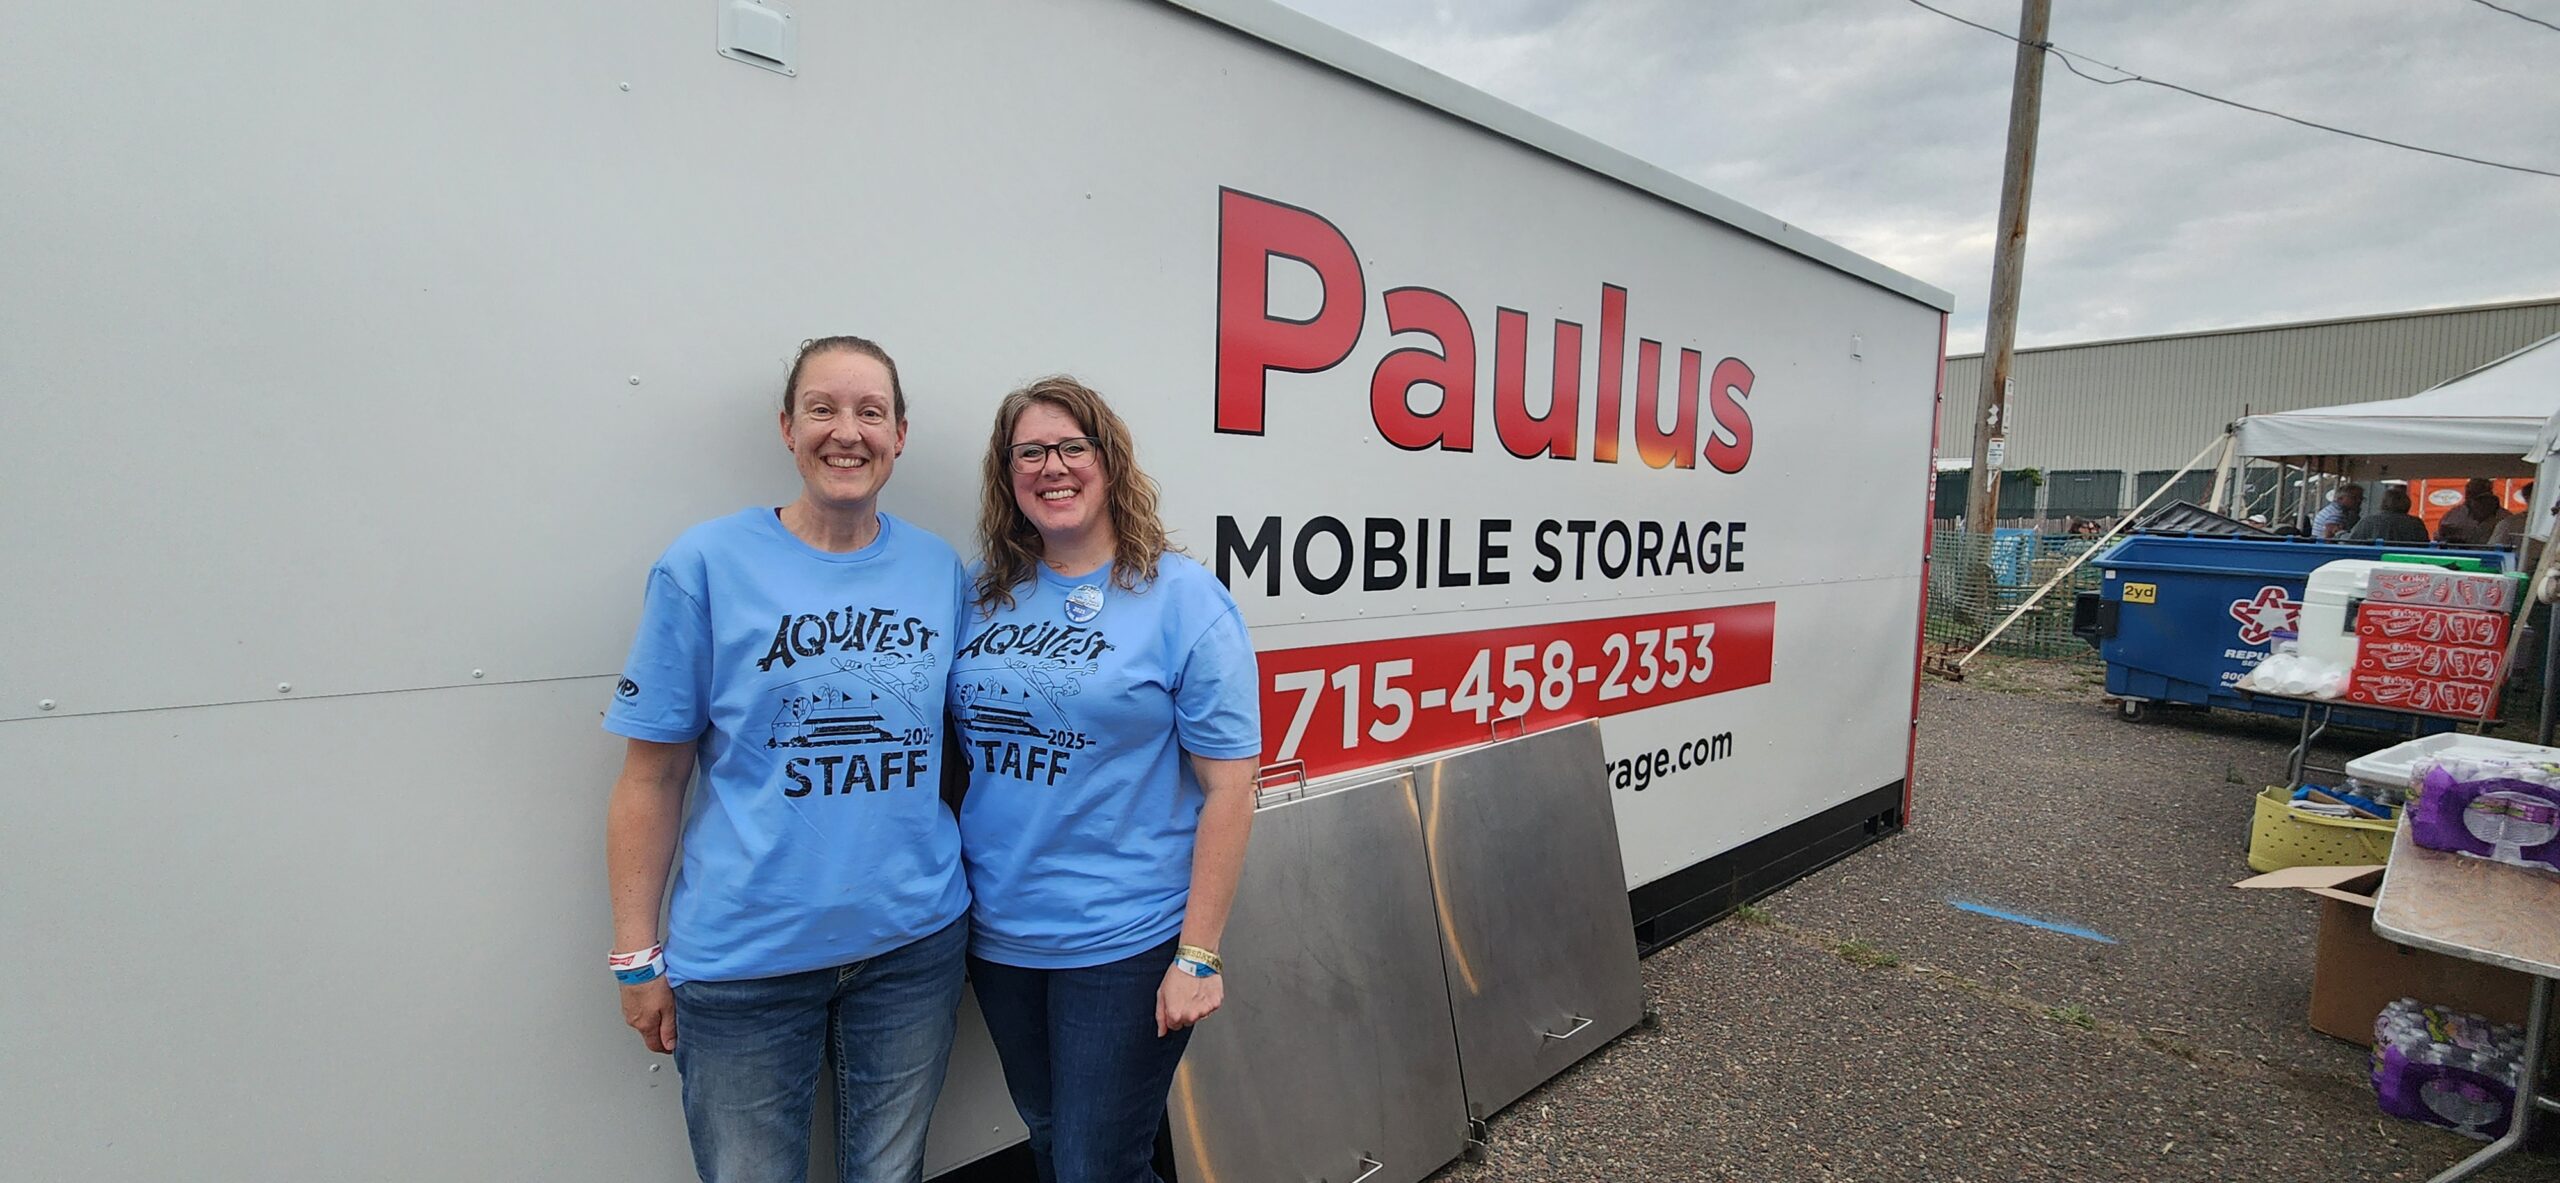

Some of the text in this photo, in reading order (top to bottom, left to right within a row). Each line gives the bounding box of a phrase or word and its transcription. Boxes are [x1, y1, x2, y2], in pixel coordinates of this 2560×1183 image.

[1214, 185, 1755, 474] Paulus
[1215, 515, 1747, 597] MOBILE STORAGE
[2125, 585, 2154, 599] 2yd
[756, 605, 939, 672] AQUAFEST
[956, 621, 1118, 661] AQUAFEST
[1273, 622, 1715, 762] 715-458-2353
[784, 750, 928, 798] STAFF
